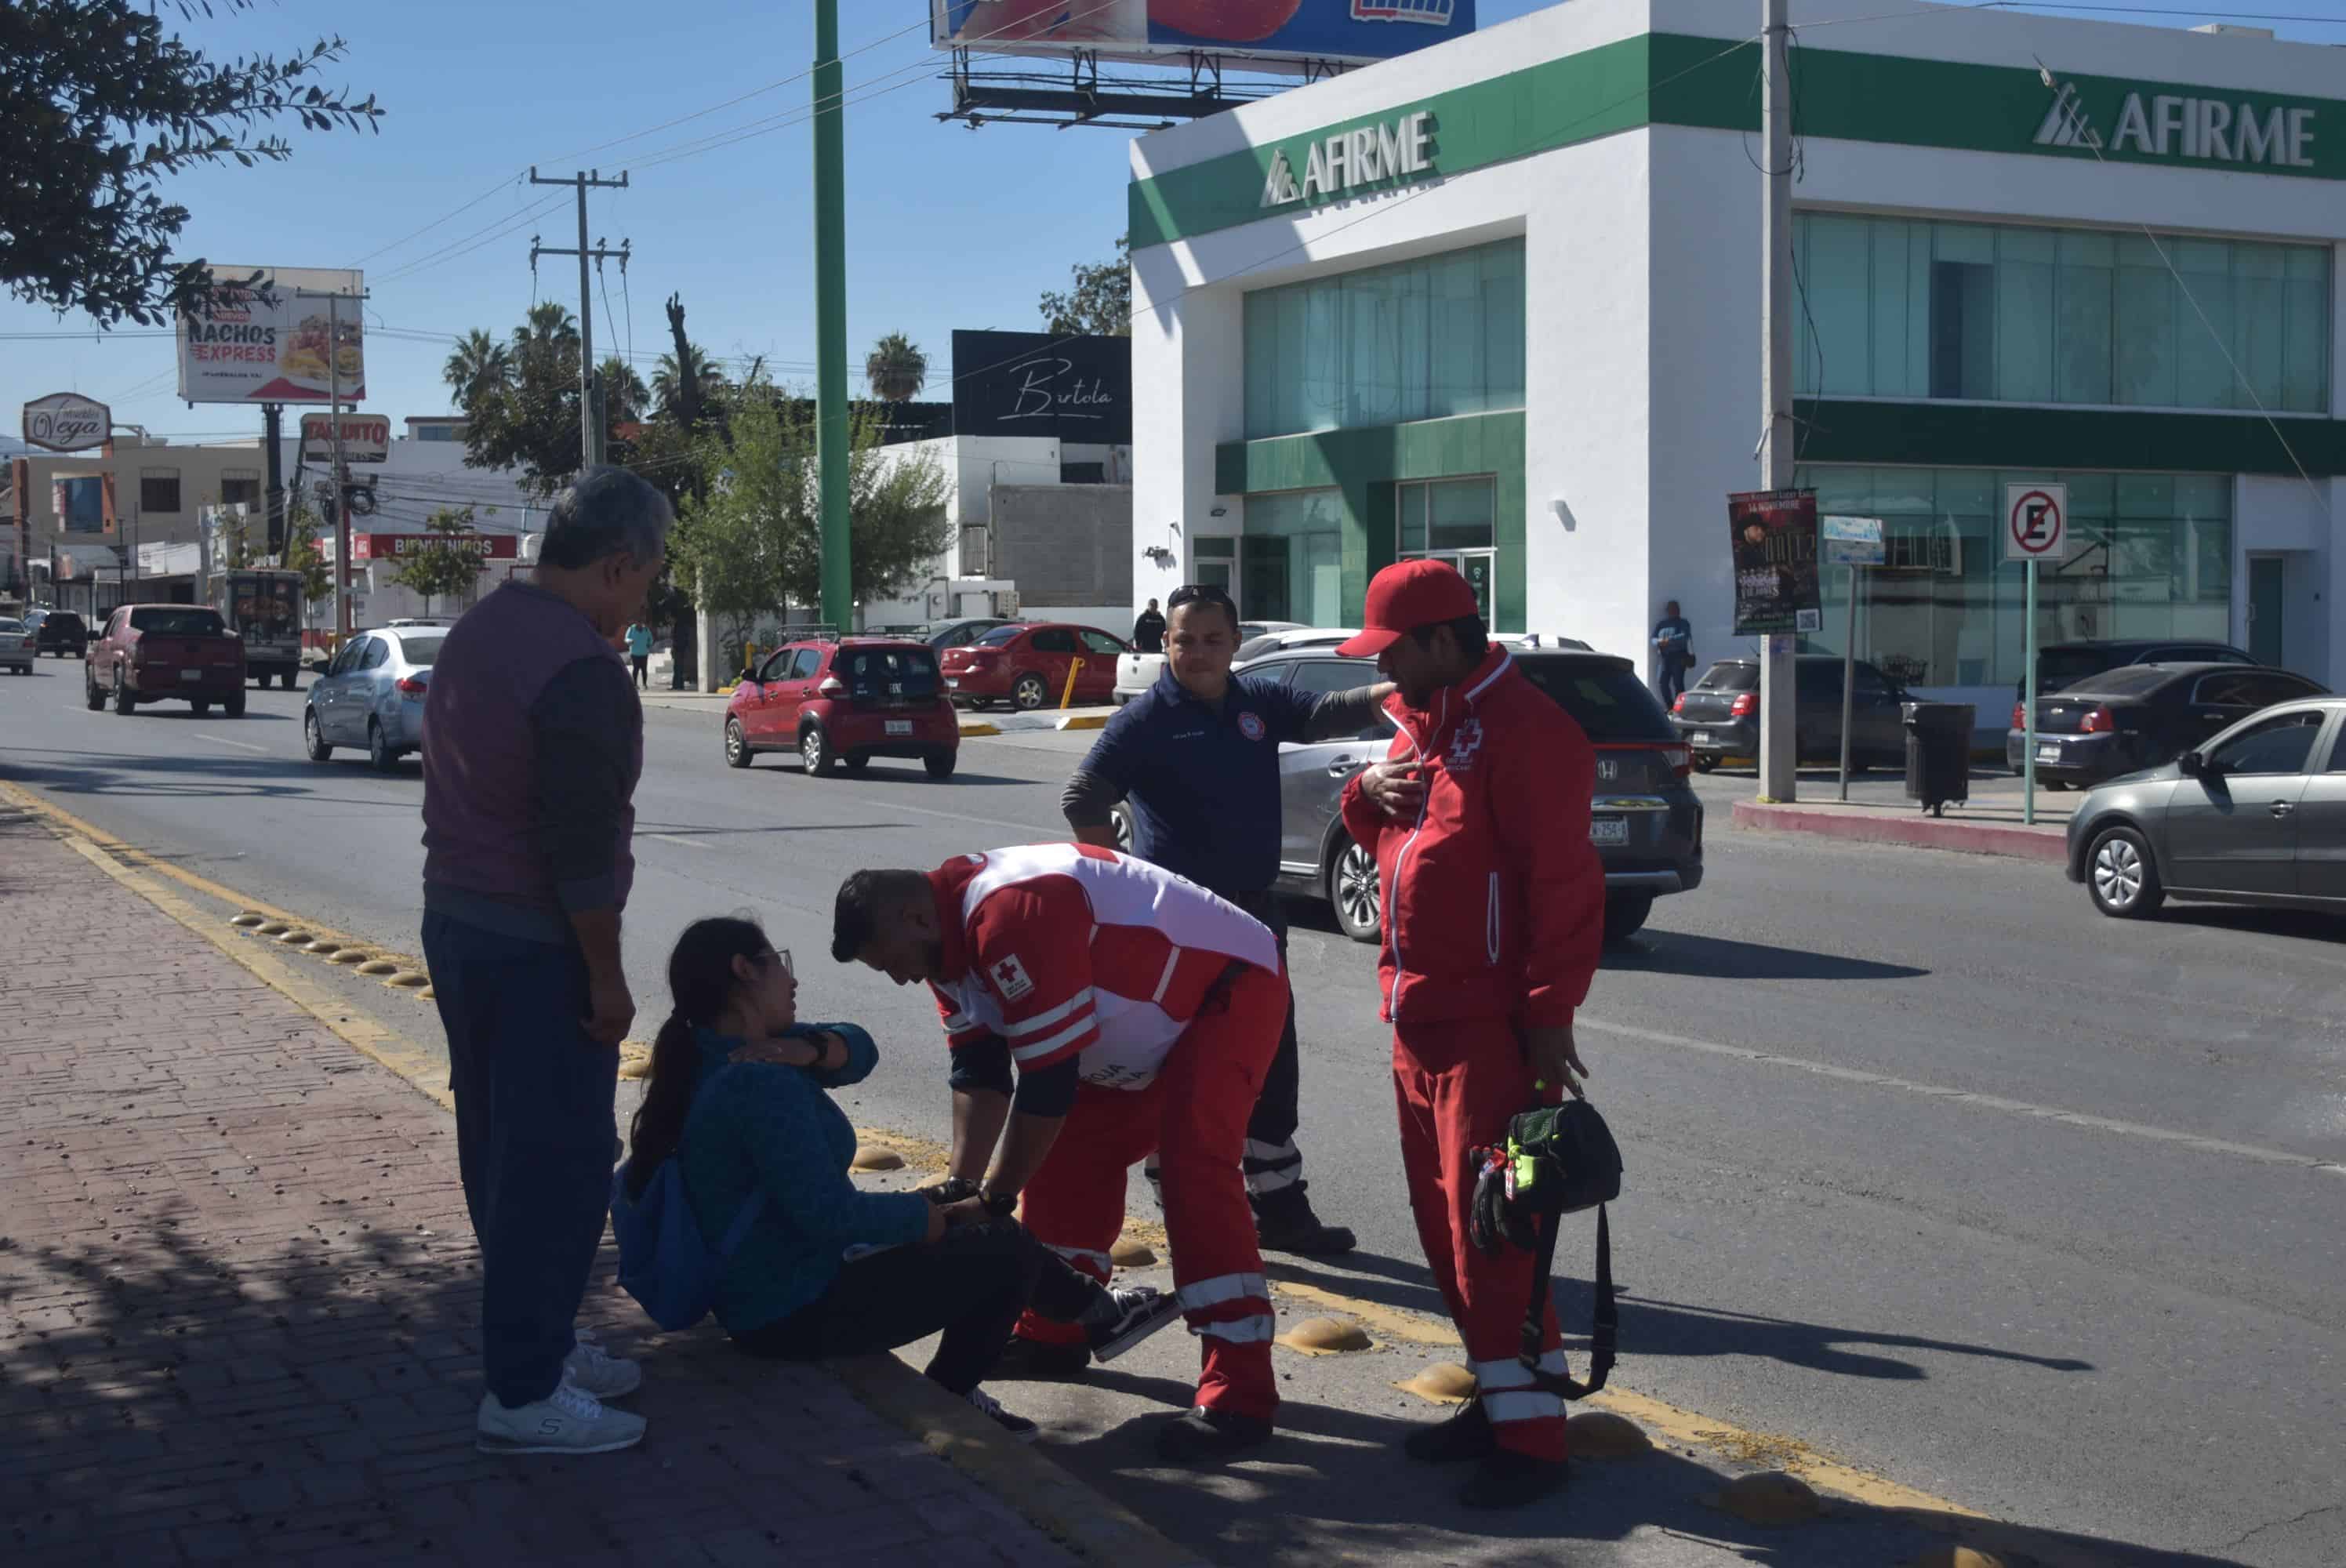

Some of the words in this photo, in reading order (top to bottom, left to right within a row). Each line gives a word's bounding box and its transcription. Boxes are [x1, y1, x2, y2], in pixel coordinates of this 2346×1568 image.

[2112, 92, 2315, 167] AFIRME
[1302, 110, 1431, 198] AFIRME
[188, 324, 274, 345] NACHOS
[191, 344, 275, 363] EXPRESS
[307, 420, 387, 445] TAUITO
[2026, 505, 2046, 539] E
